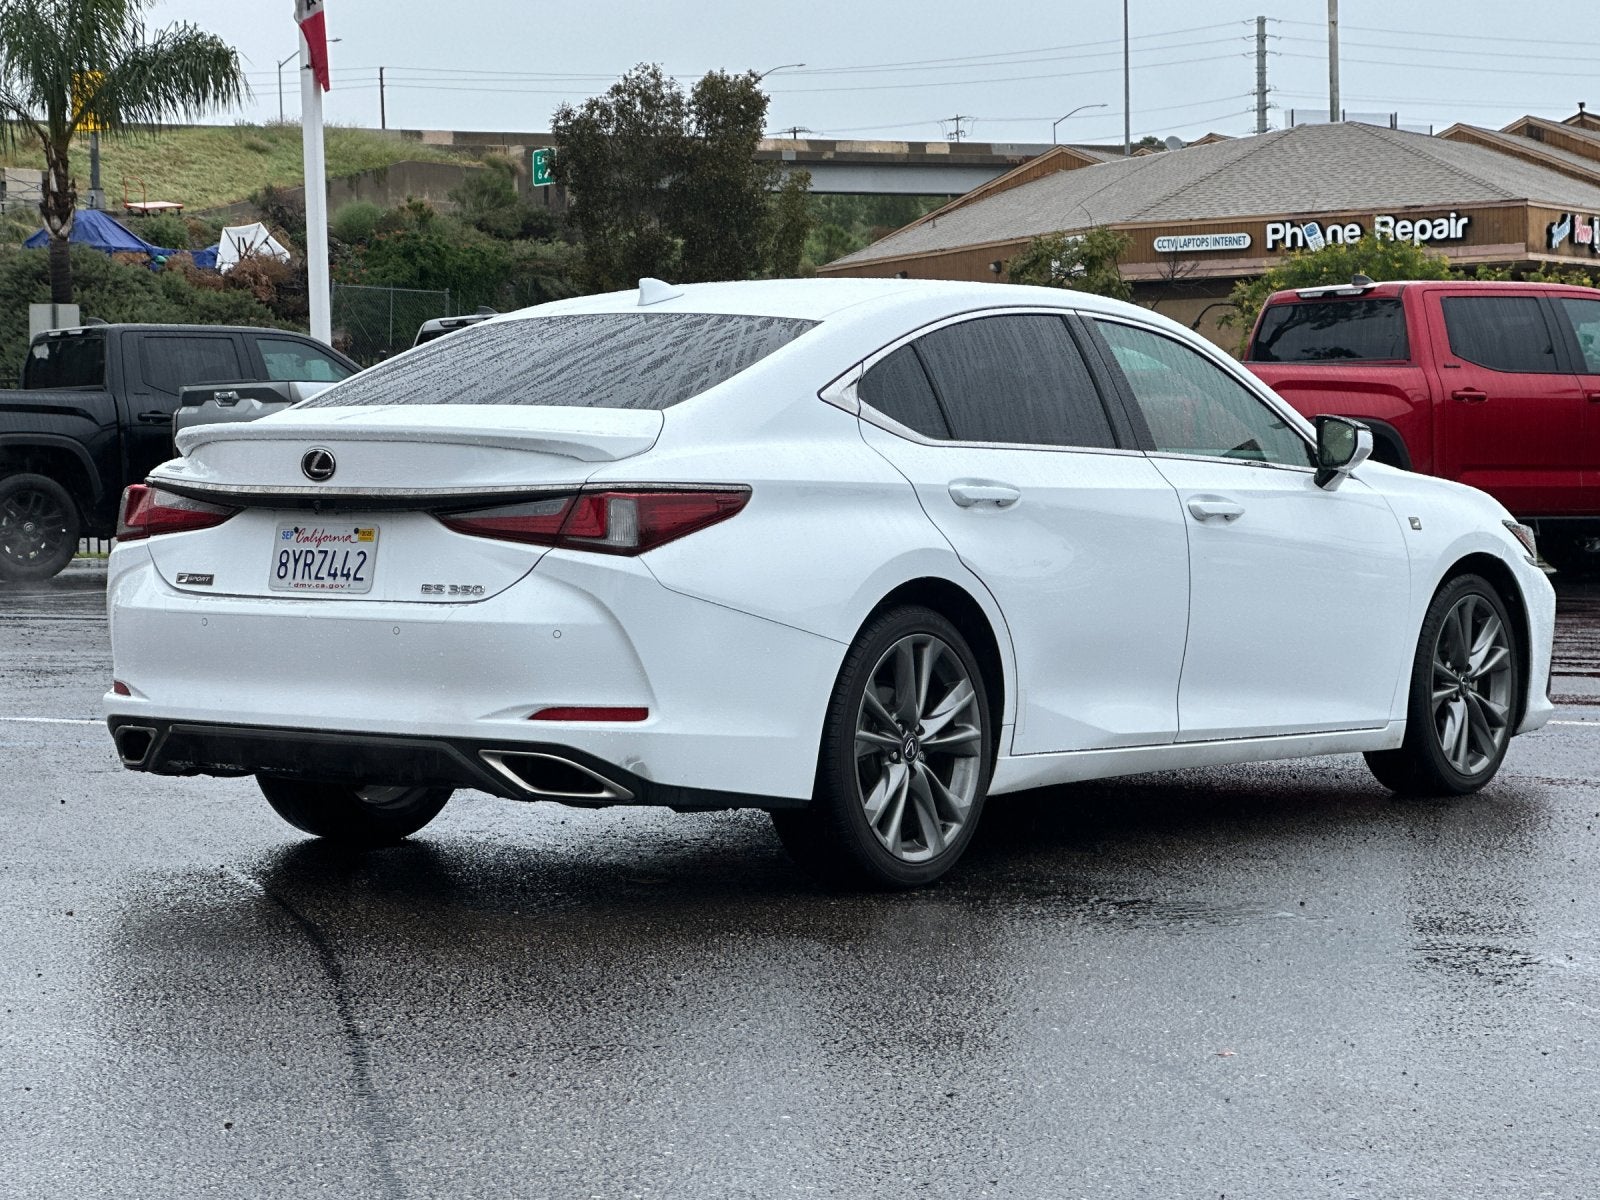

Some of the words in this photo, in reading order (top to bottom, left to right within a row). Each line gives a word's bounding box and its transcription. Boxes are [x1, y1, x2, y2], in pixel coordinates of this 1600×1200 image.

[1374, 212, 1469, 246] Repair
[1157, 239, 1176, 249] CCTV
[1179, 237, 1210, 249] LAPTOPS
[1212, 235, 1247, 247] INTERNET
[281, 530, 294, 540] SEP
[296, 528, 358, 548] California
[277, 549, 367, 581] 8YRZ442
[421, 583, 446, 595] ES
[448, 584, 486, 596] 350
